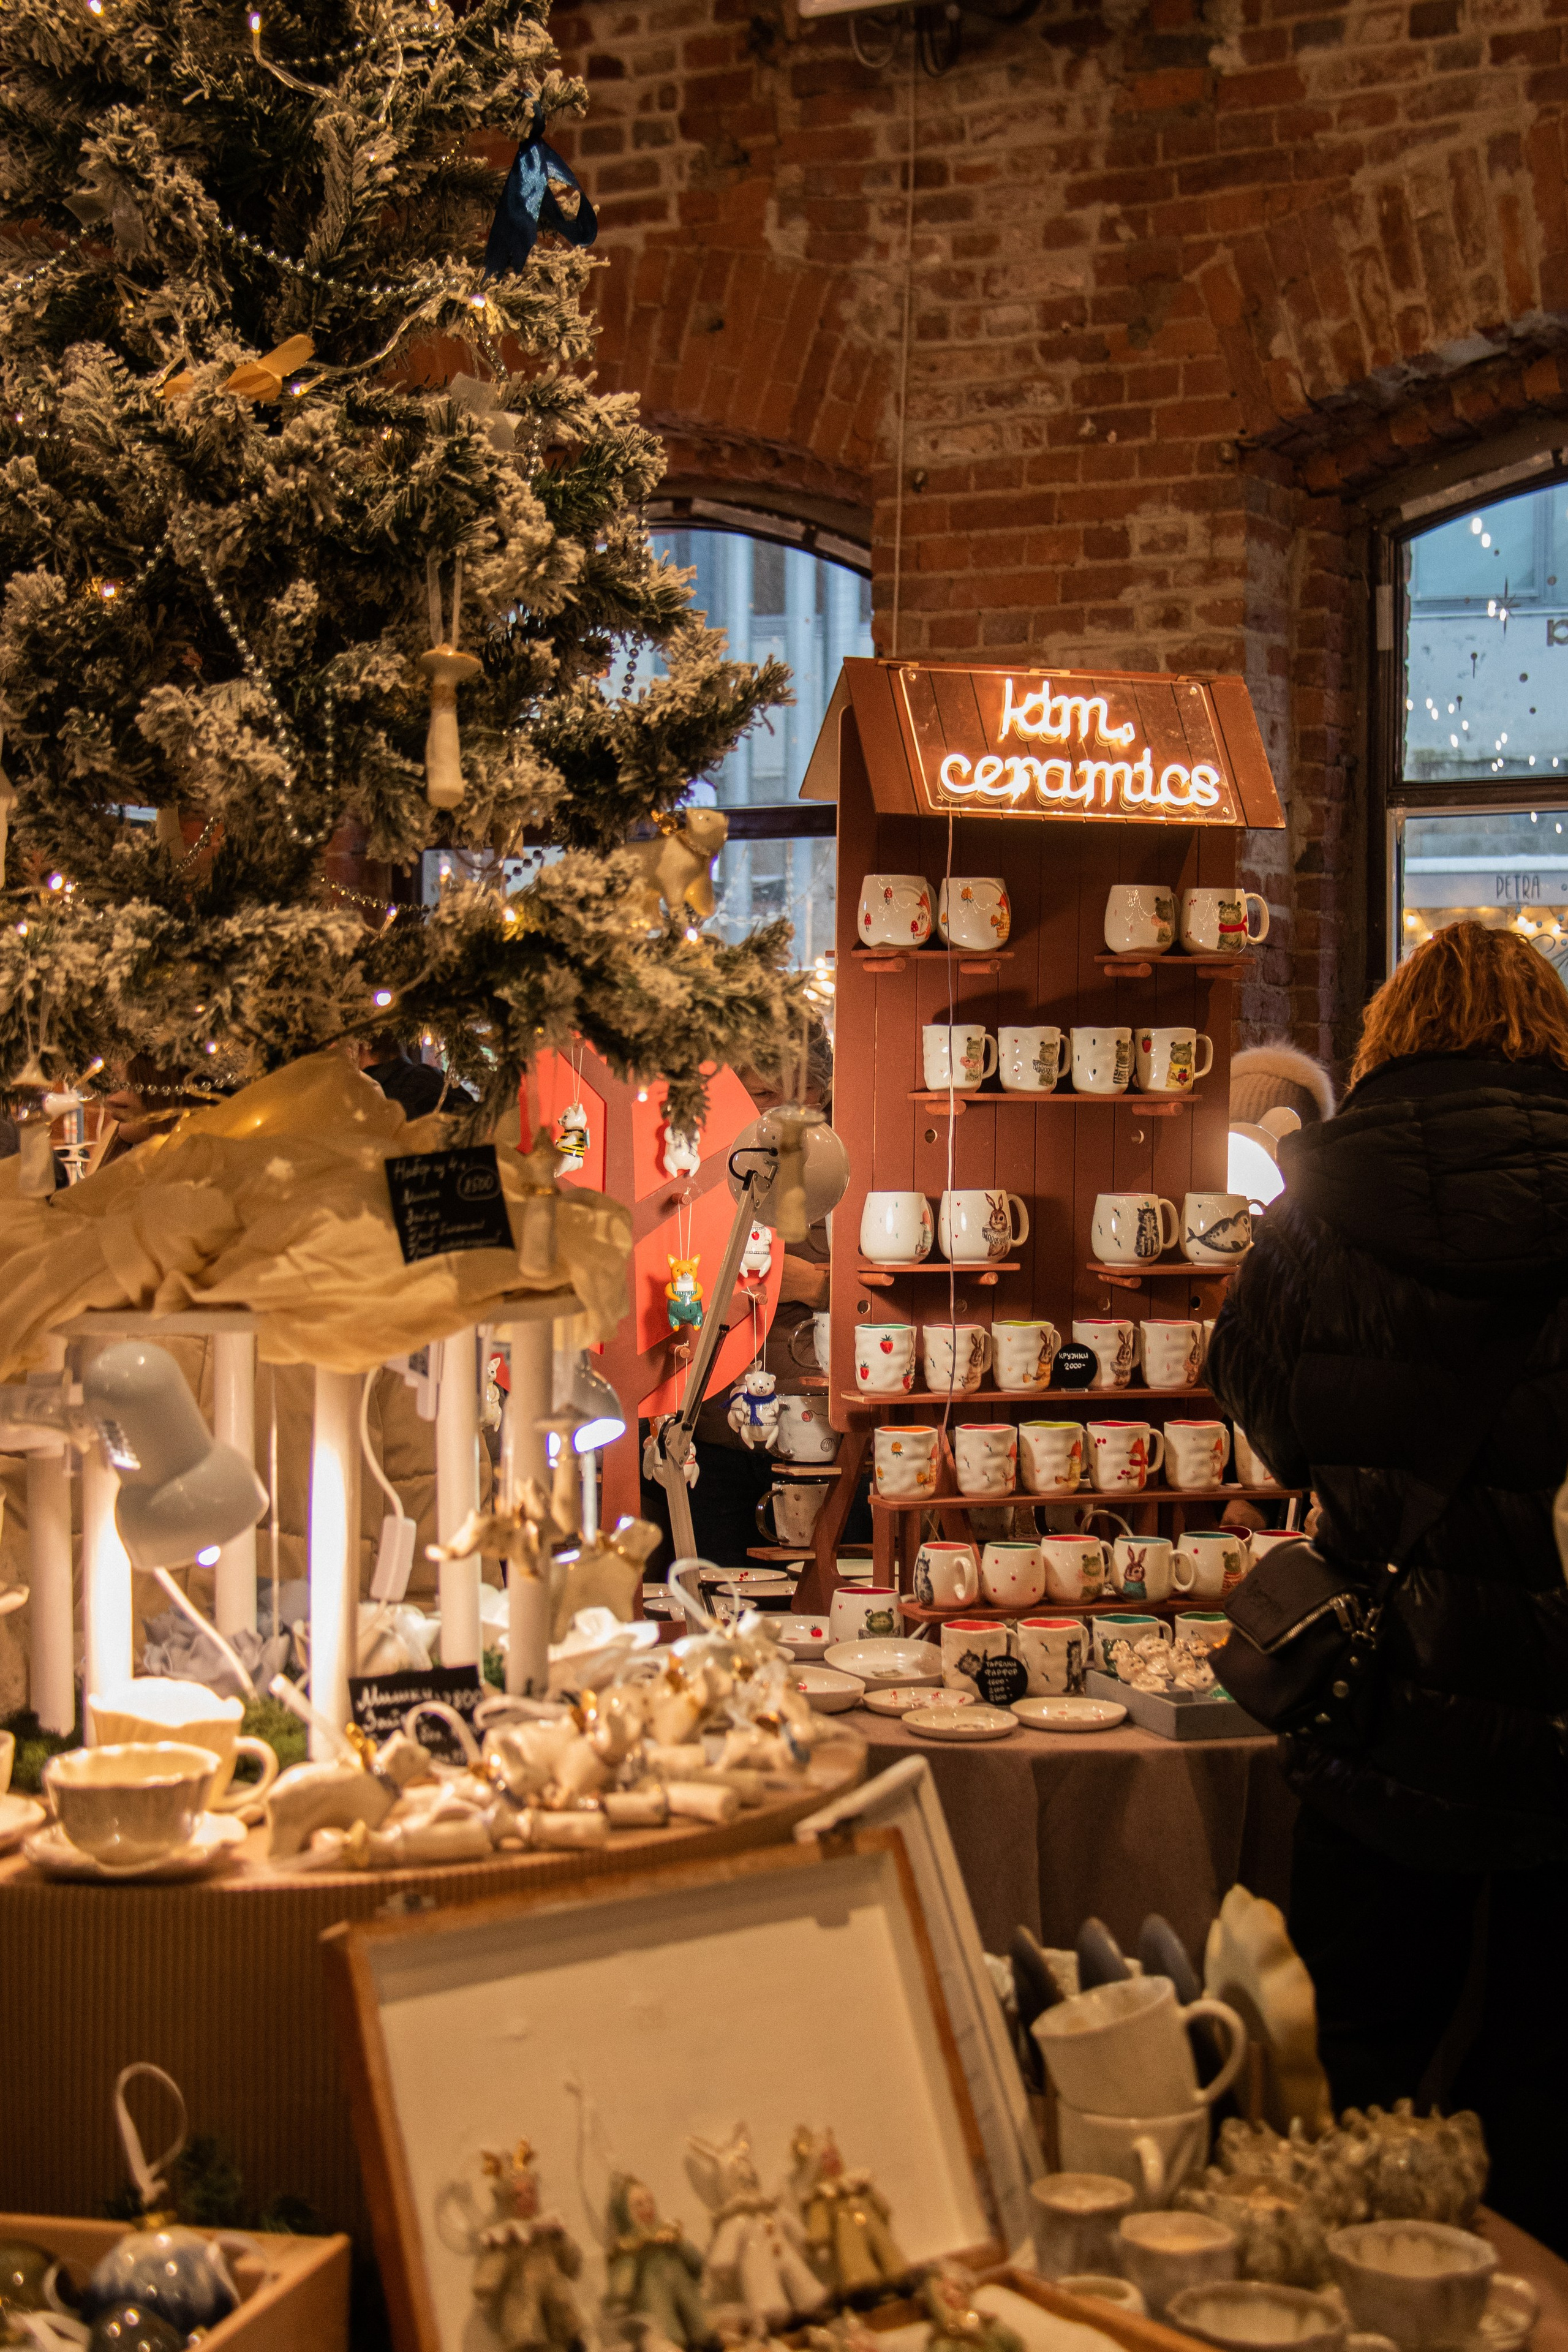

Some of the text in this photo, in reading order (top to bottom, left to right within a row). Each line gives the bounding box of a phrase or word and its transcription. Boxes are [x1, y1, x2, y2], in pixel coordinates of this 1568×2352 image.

[940, 748, 1219, 807] ceramics
[1496, 875, 1540, 900] PETRA
[984, 1668, 1018, 1677] ФАРФОР
